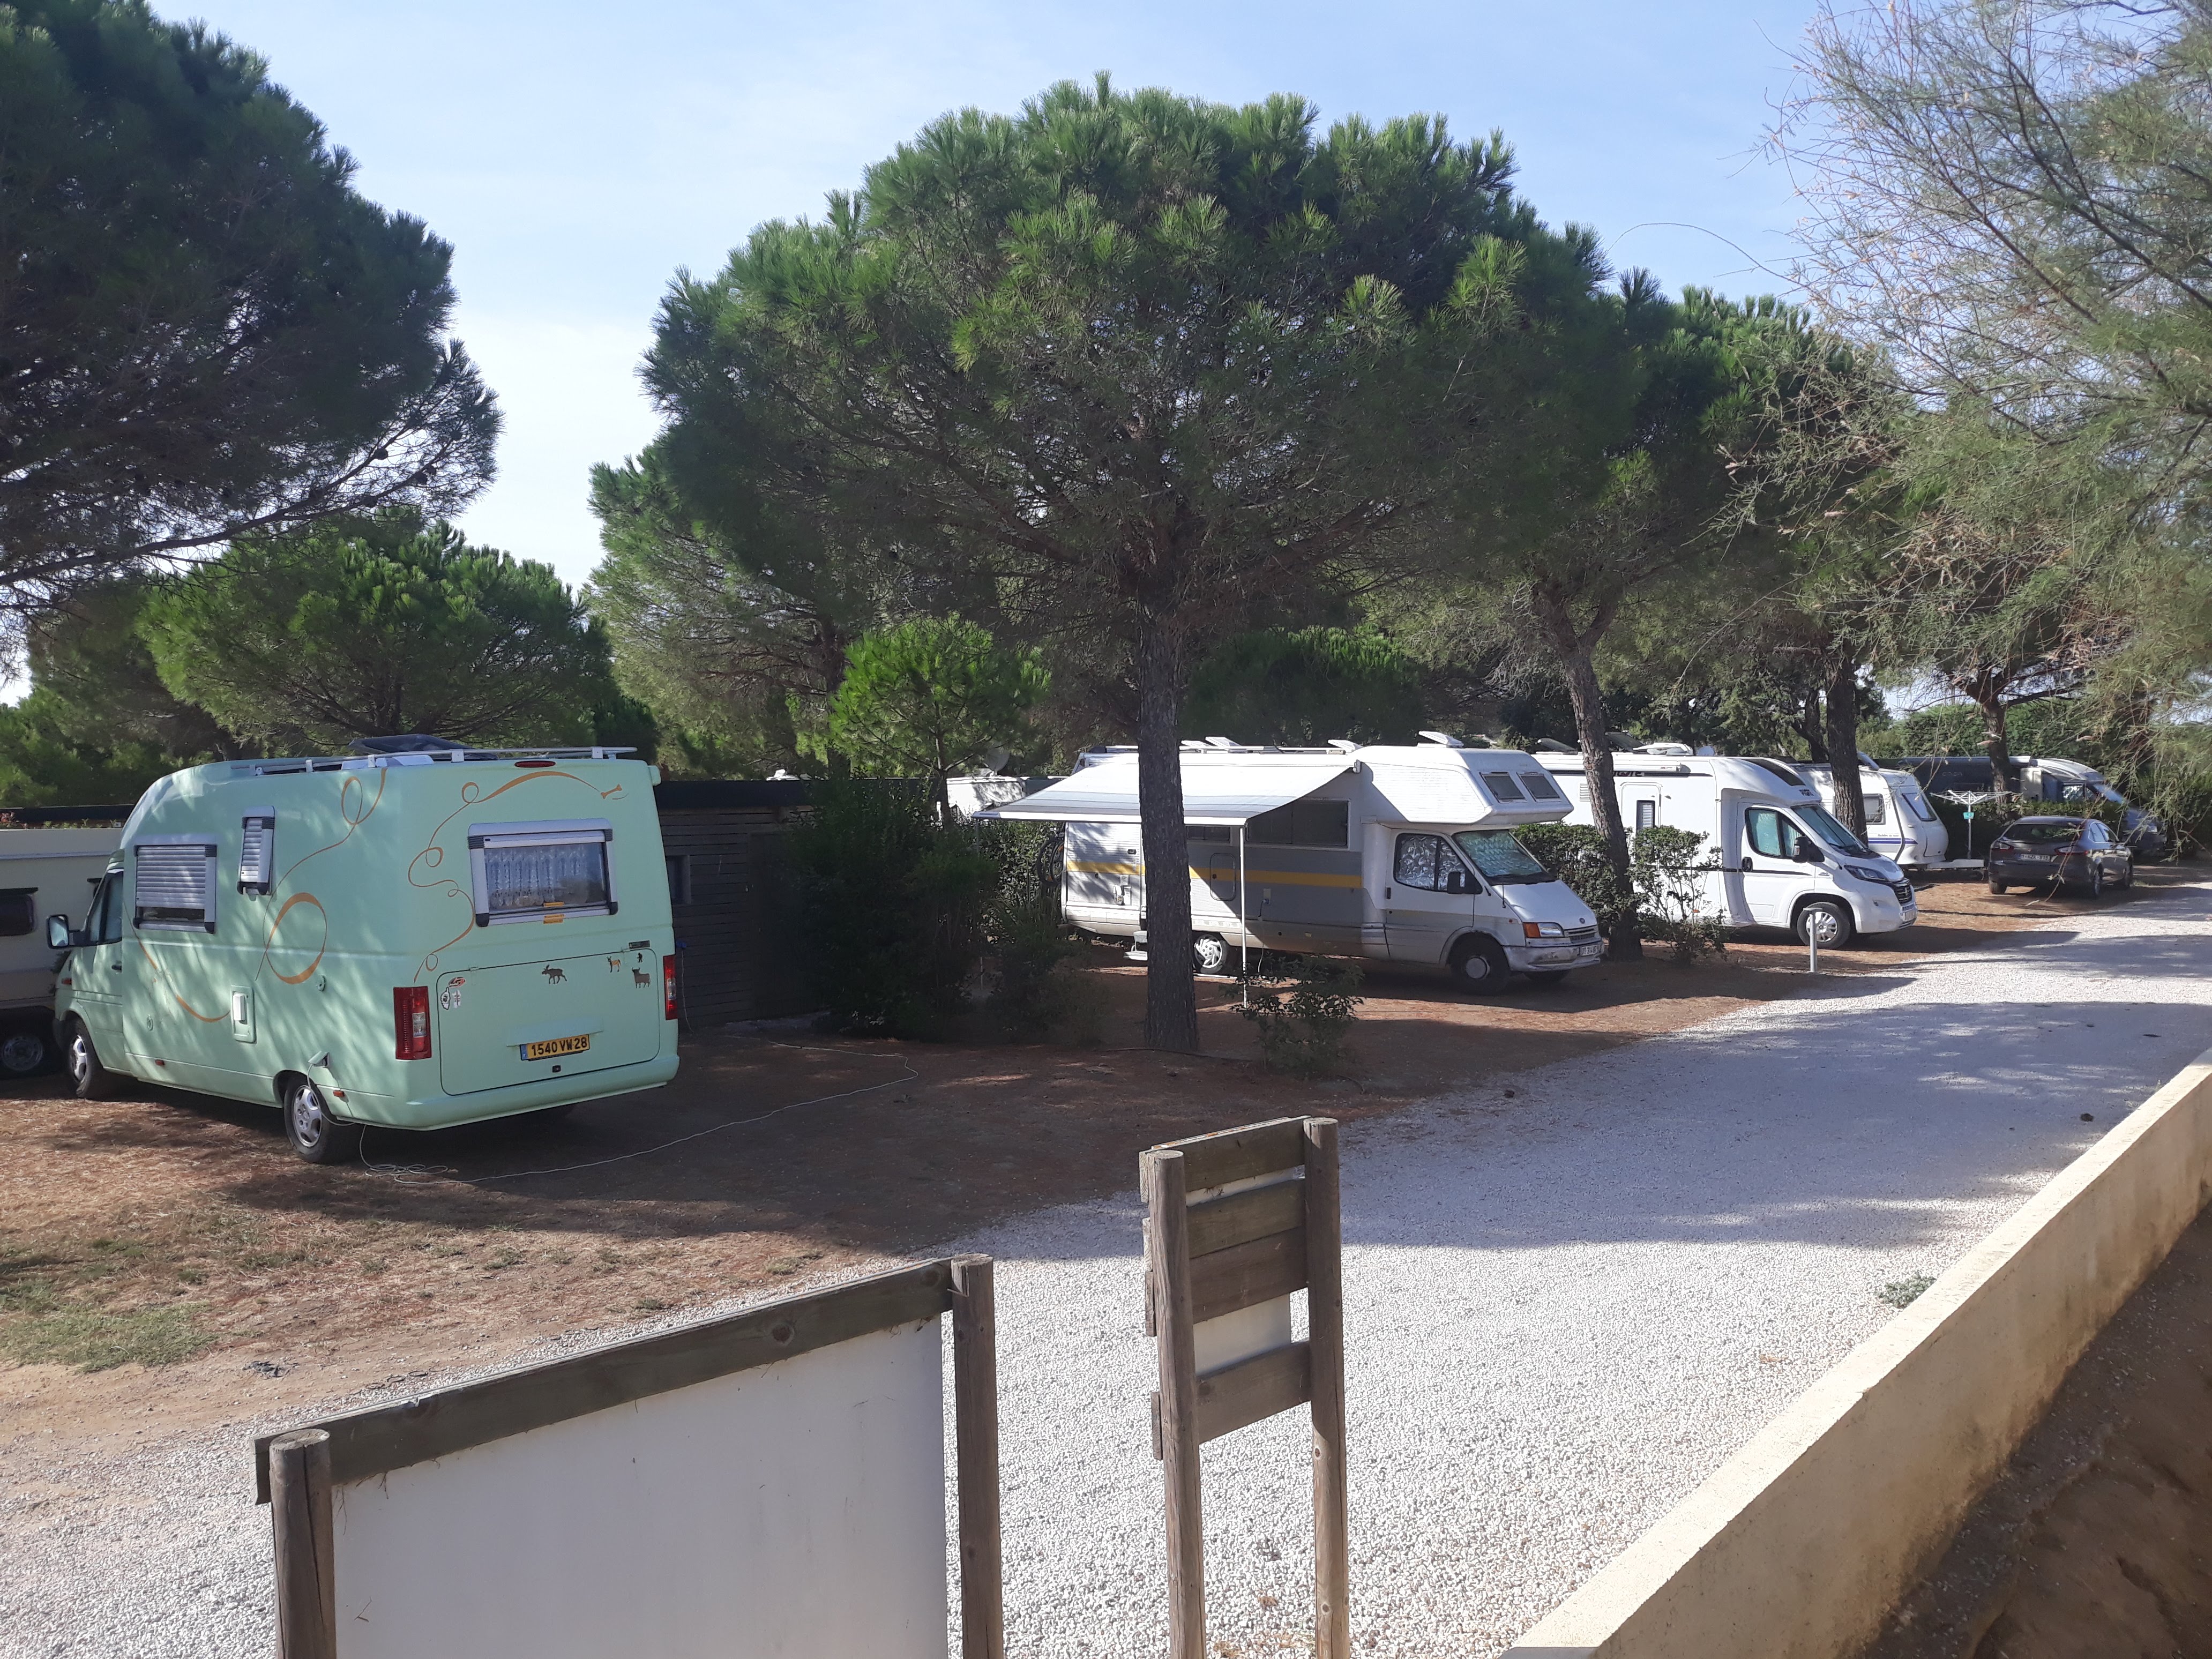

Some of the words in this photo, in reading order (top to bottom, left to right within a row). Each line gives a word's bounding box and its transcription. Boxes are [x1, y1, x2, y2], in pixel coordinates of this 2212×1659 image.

[532, 1041, 558, 1056] 1540
[559, 1039, 572, 1051] VW
[574, 1037, 587, 1049] 28
